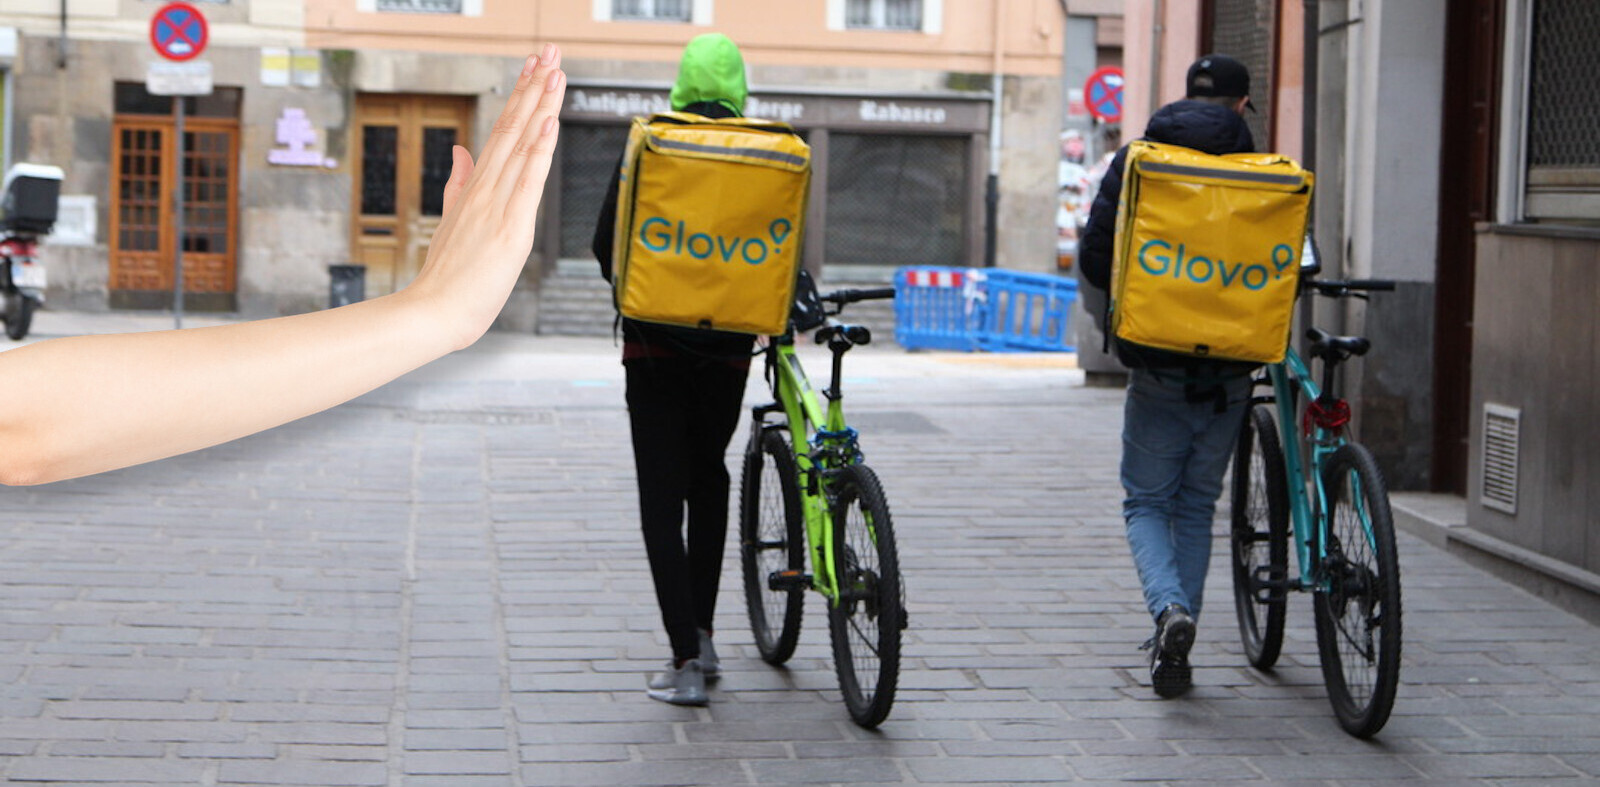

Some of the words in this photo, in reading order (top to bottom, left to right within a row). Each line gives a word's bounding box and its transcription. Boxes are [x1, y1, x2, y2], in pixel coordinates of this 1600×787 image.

[859, 100, 946, 123] Rabasco
[639, 216, 769, 265] Glovo
[1137, 239, 1269, 291] Glovo
